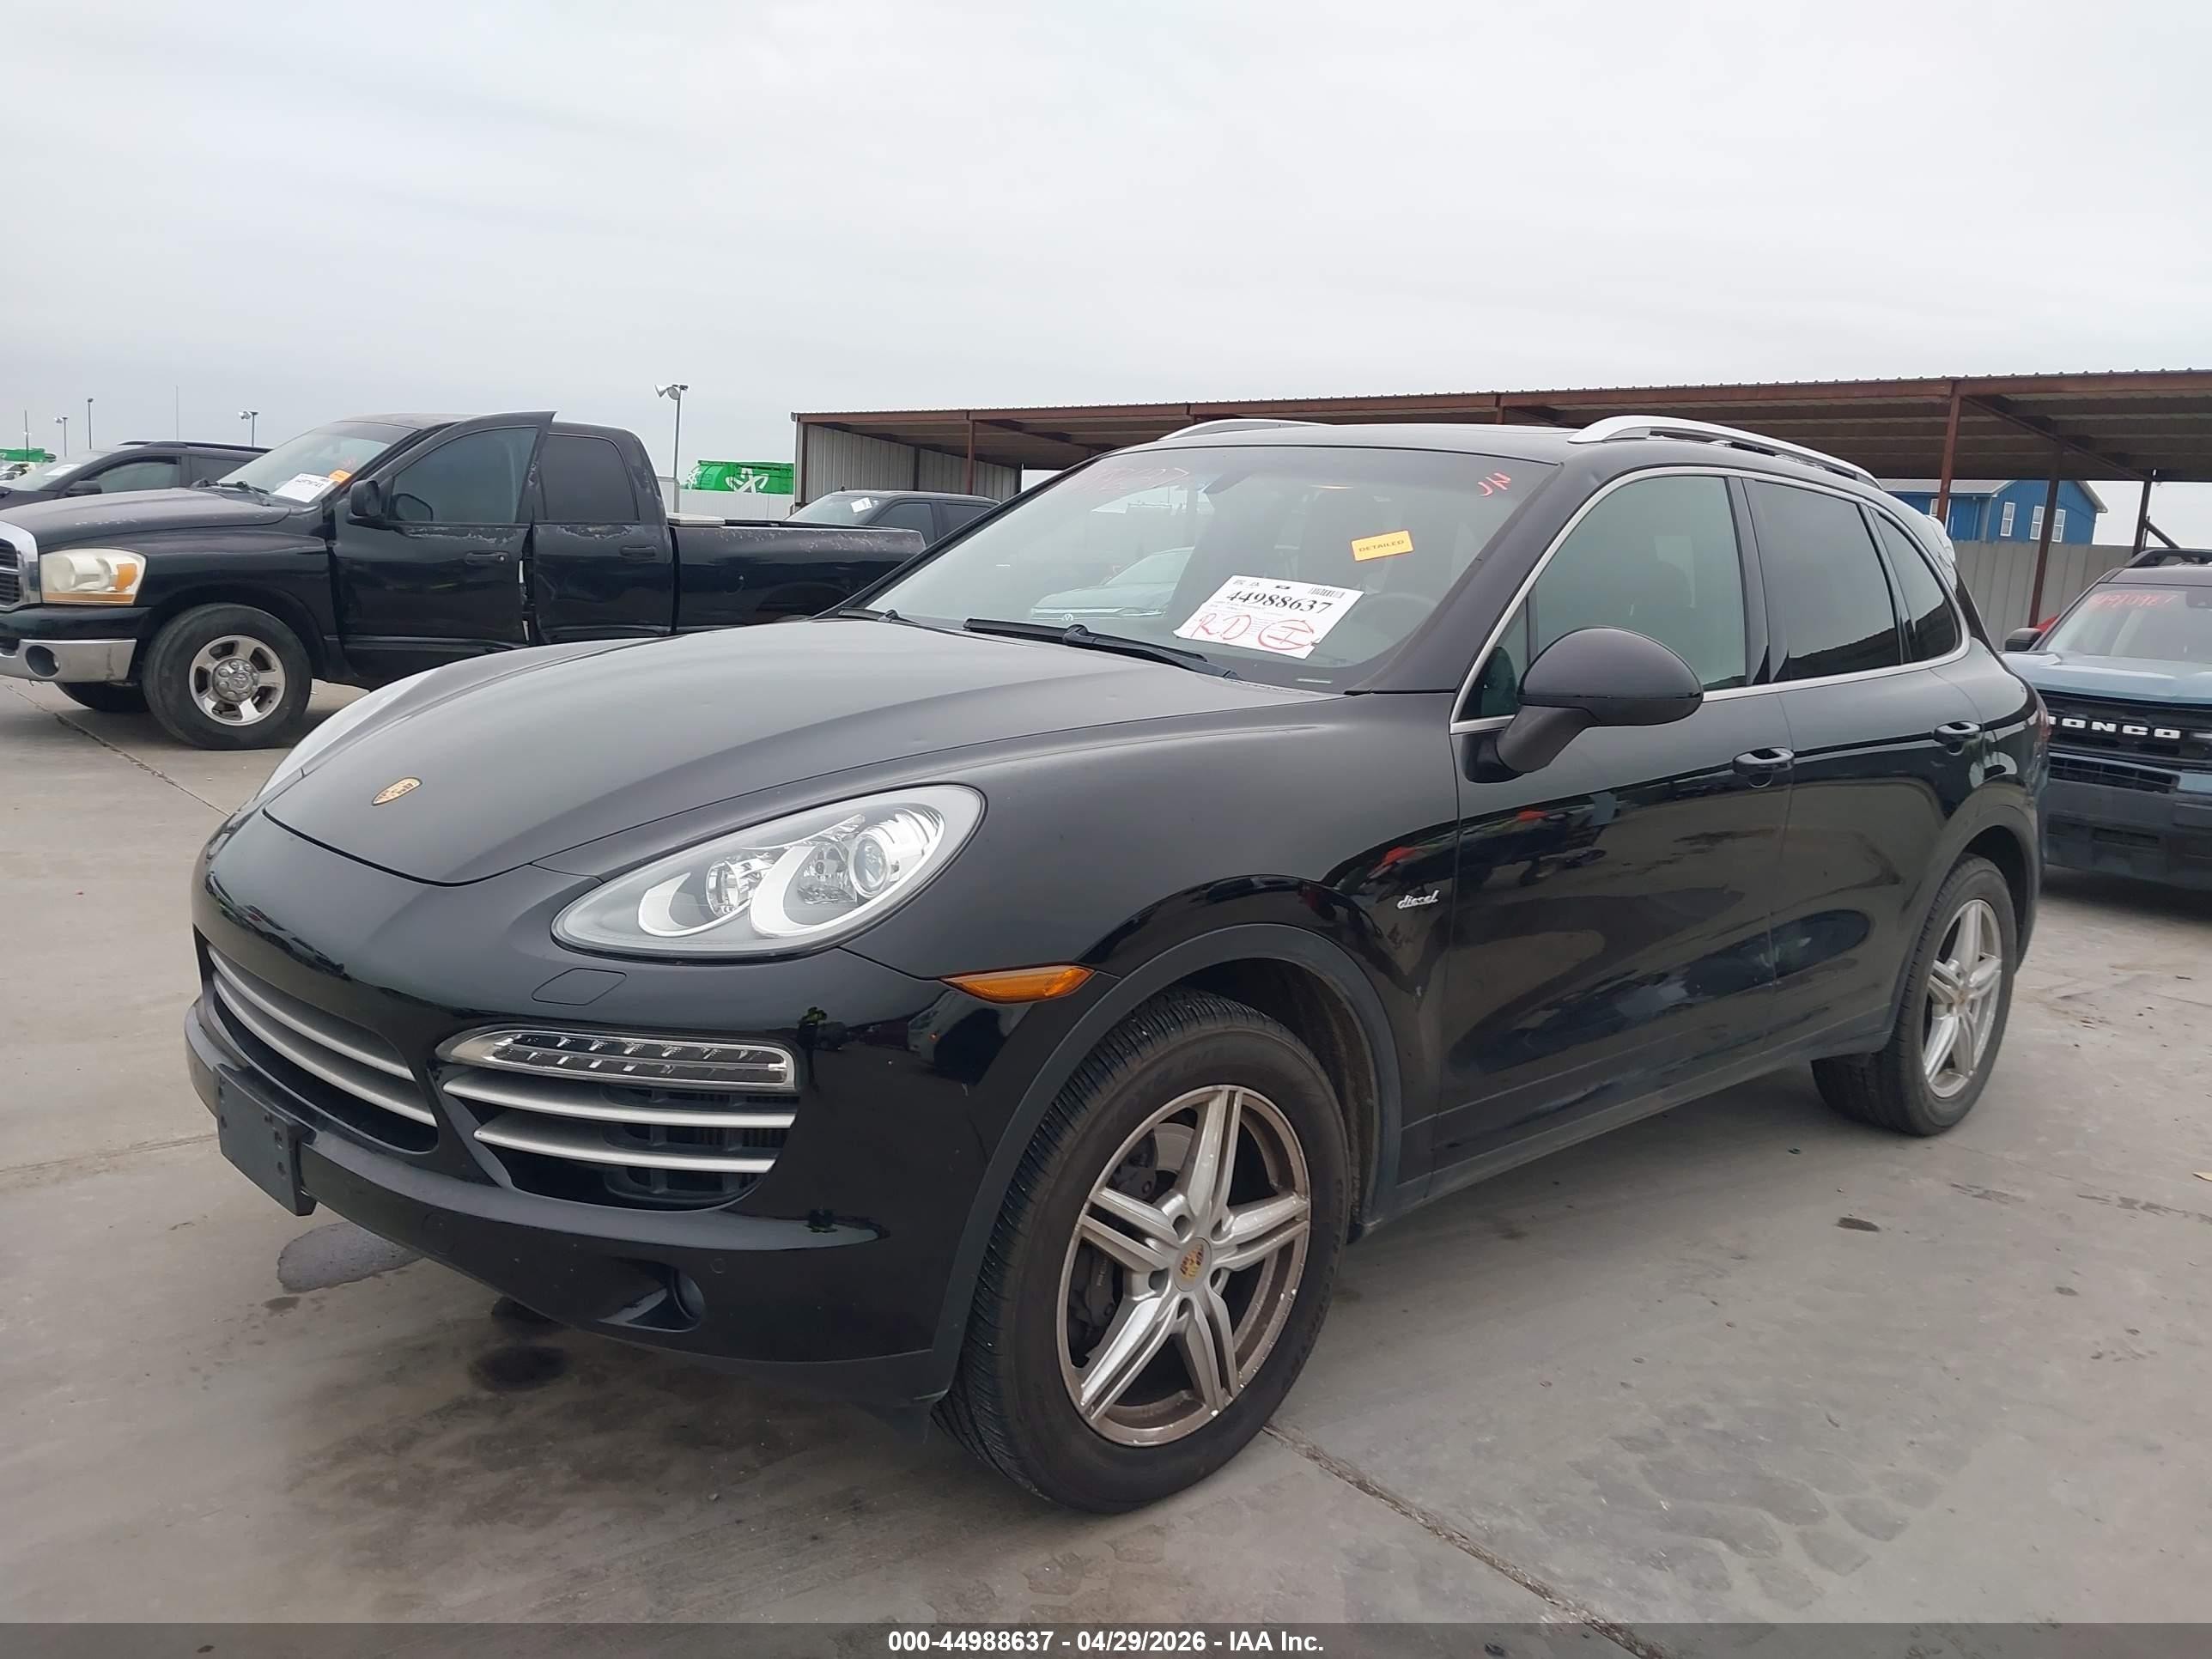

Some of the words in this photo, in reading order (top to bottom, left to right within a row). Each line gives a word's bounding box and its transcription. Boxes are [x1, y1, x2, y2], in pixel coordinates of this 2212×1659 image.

[1358, 539, 1405, 552] DETAILED
[1226, 591, 1333, 613] 44988637
[1397, 890, 1439, 908] diesel
